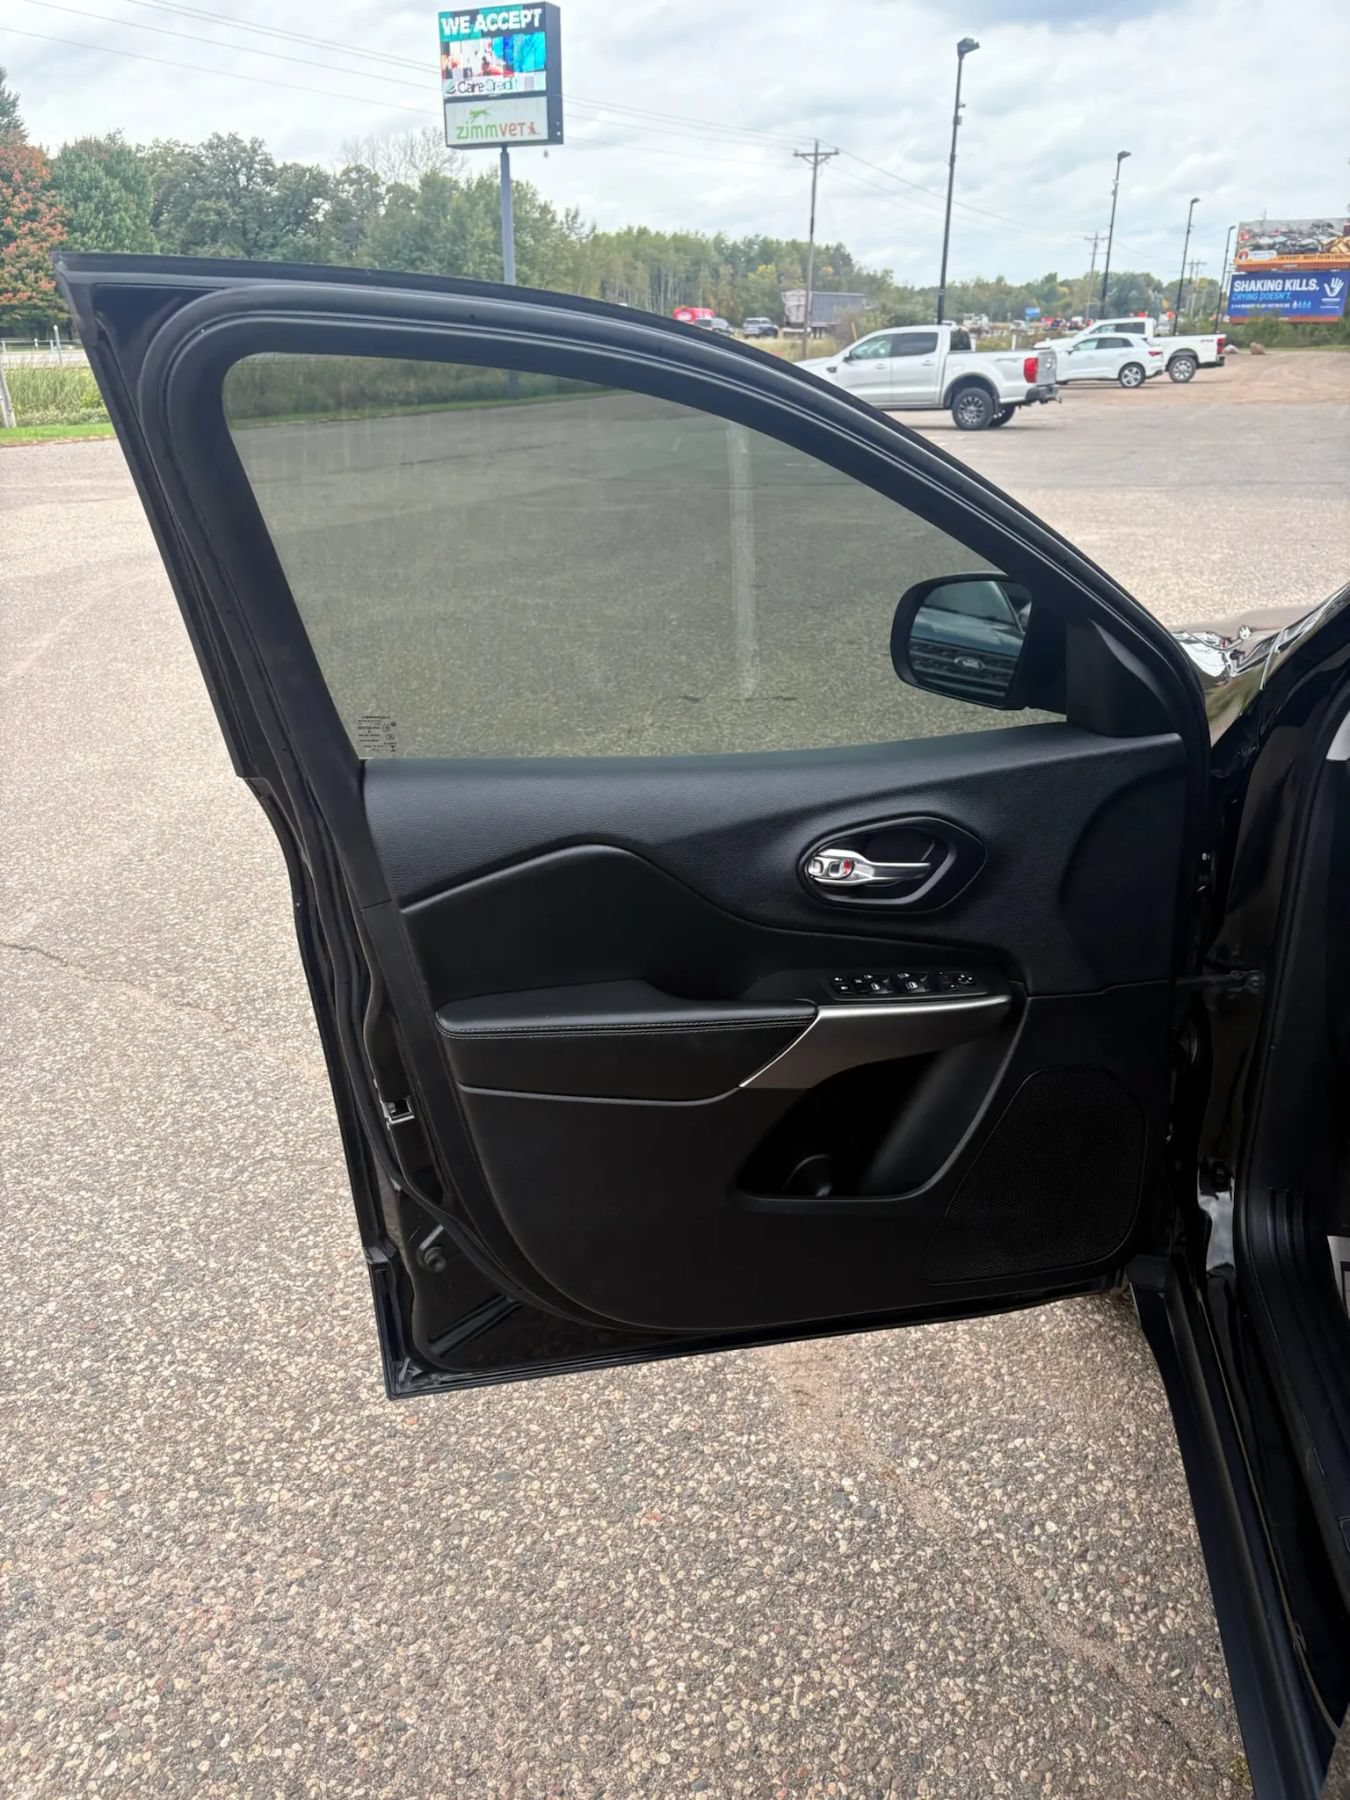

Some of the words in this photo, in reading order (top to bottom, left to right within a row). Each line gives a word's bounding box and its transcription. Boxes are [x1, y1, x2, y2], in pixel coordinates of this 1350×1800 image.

[440, 16, 471, 36] WE
[474, 9, 542, 32] ACCEPT
[458, 79, 518, 94] CareCredi
[1233, 280, 1283, 292] SHAKING
[1284, 279, 1320, 291] KILLS.
